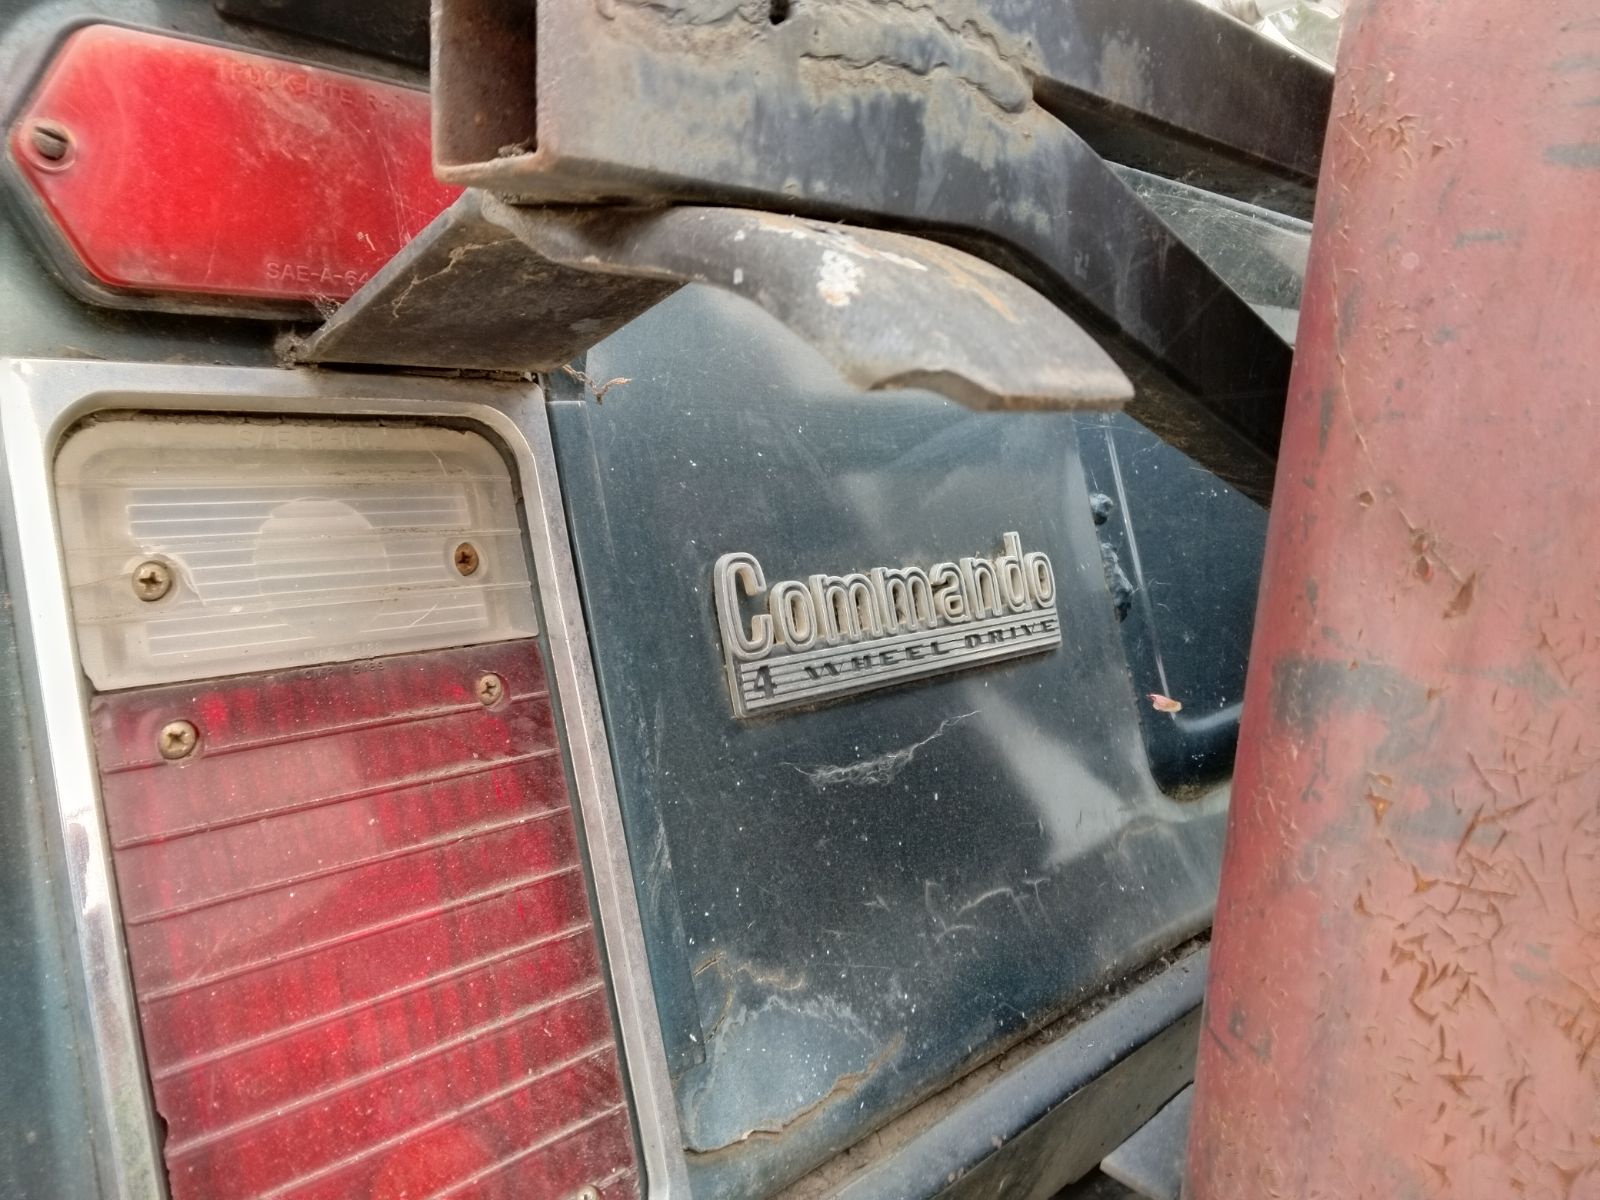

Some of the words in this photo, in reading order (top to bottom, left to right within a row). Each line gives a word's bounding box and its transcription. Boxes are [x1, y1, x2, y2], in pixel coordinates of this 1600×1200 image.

[714, 531, 1056, 660] Commando
[753, 665, 778, 699] 4
[804, 641, 951, 681] WHEEL
[964, 619, 1058, 649] DRIVE
